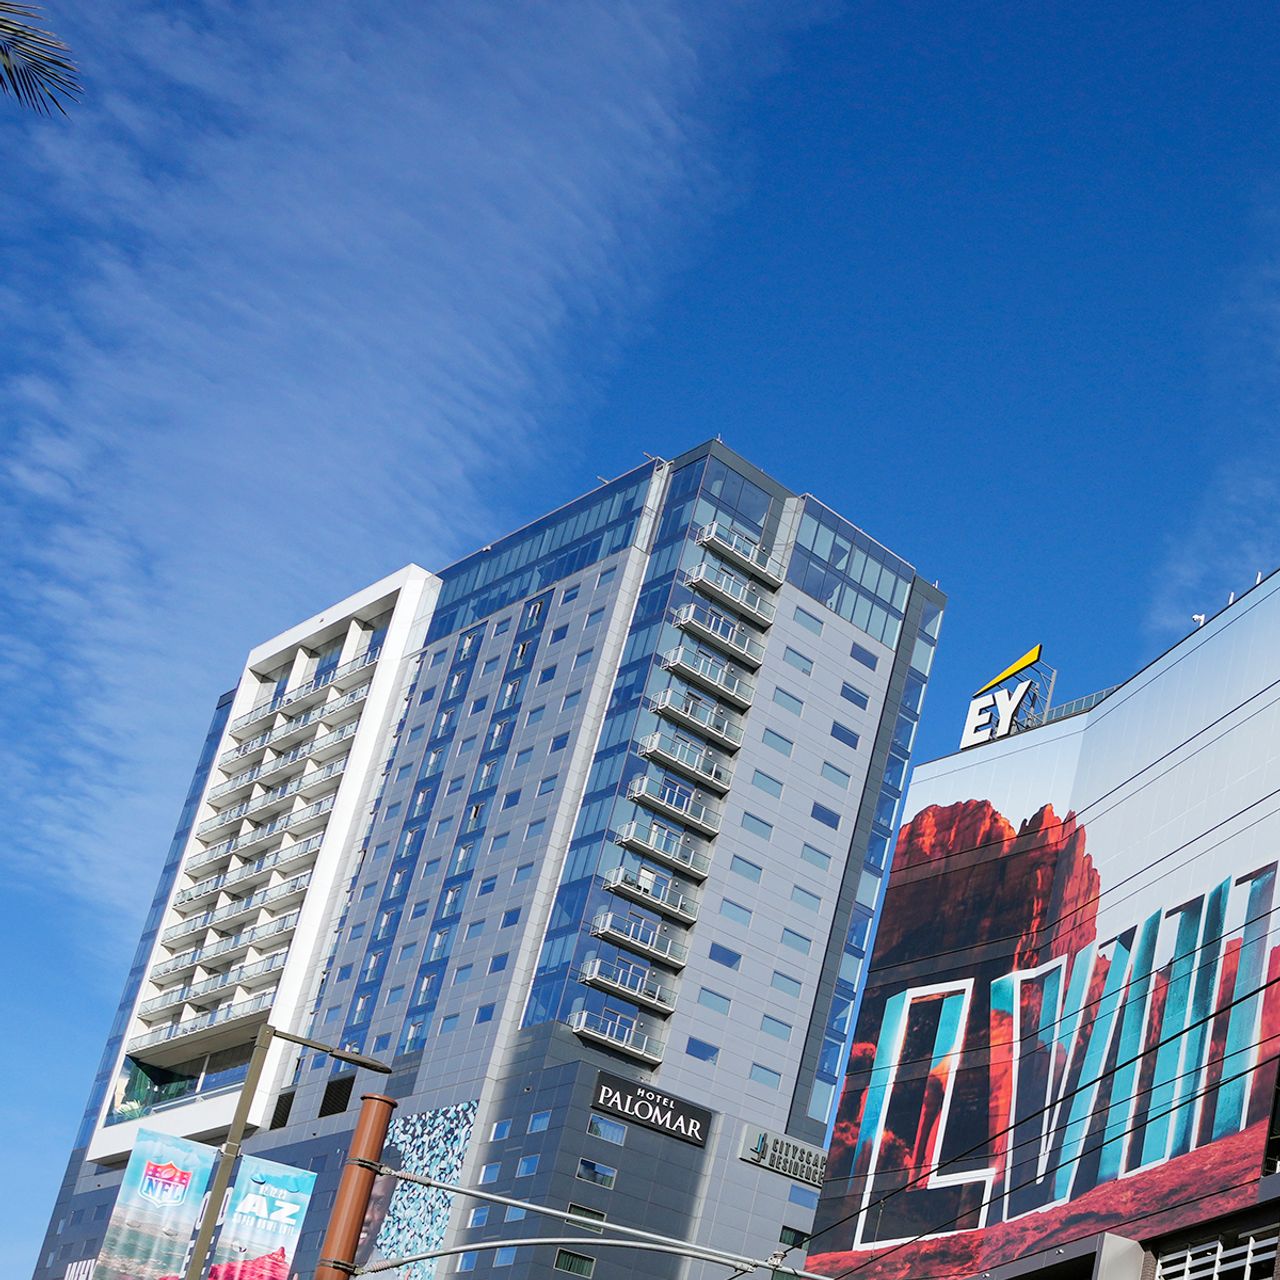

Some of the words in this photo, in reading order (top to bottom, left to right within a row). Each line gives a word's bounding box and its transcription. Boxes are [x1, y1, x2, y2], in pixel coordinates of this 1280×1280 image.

[959, 679, 1033, 750] EY
[598, 1085, 703, 1141] PALOMAR
[637, 1087, 675, 1110] HOTEL
[768, 1152, 825, 1185] RESIDENCE
[772, 1138, 826, 1170] CITYSCAP
[143, 1177, 182, 1201] NFL
[235, 1193, 301, 1226] AZ
